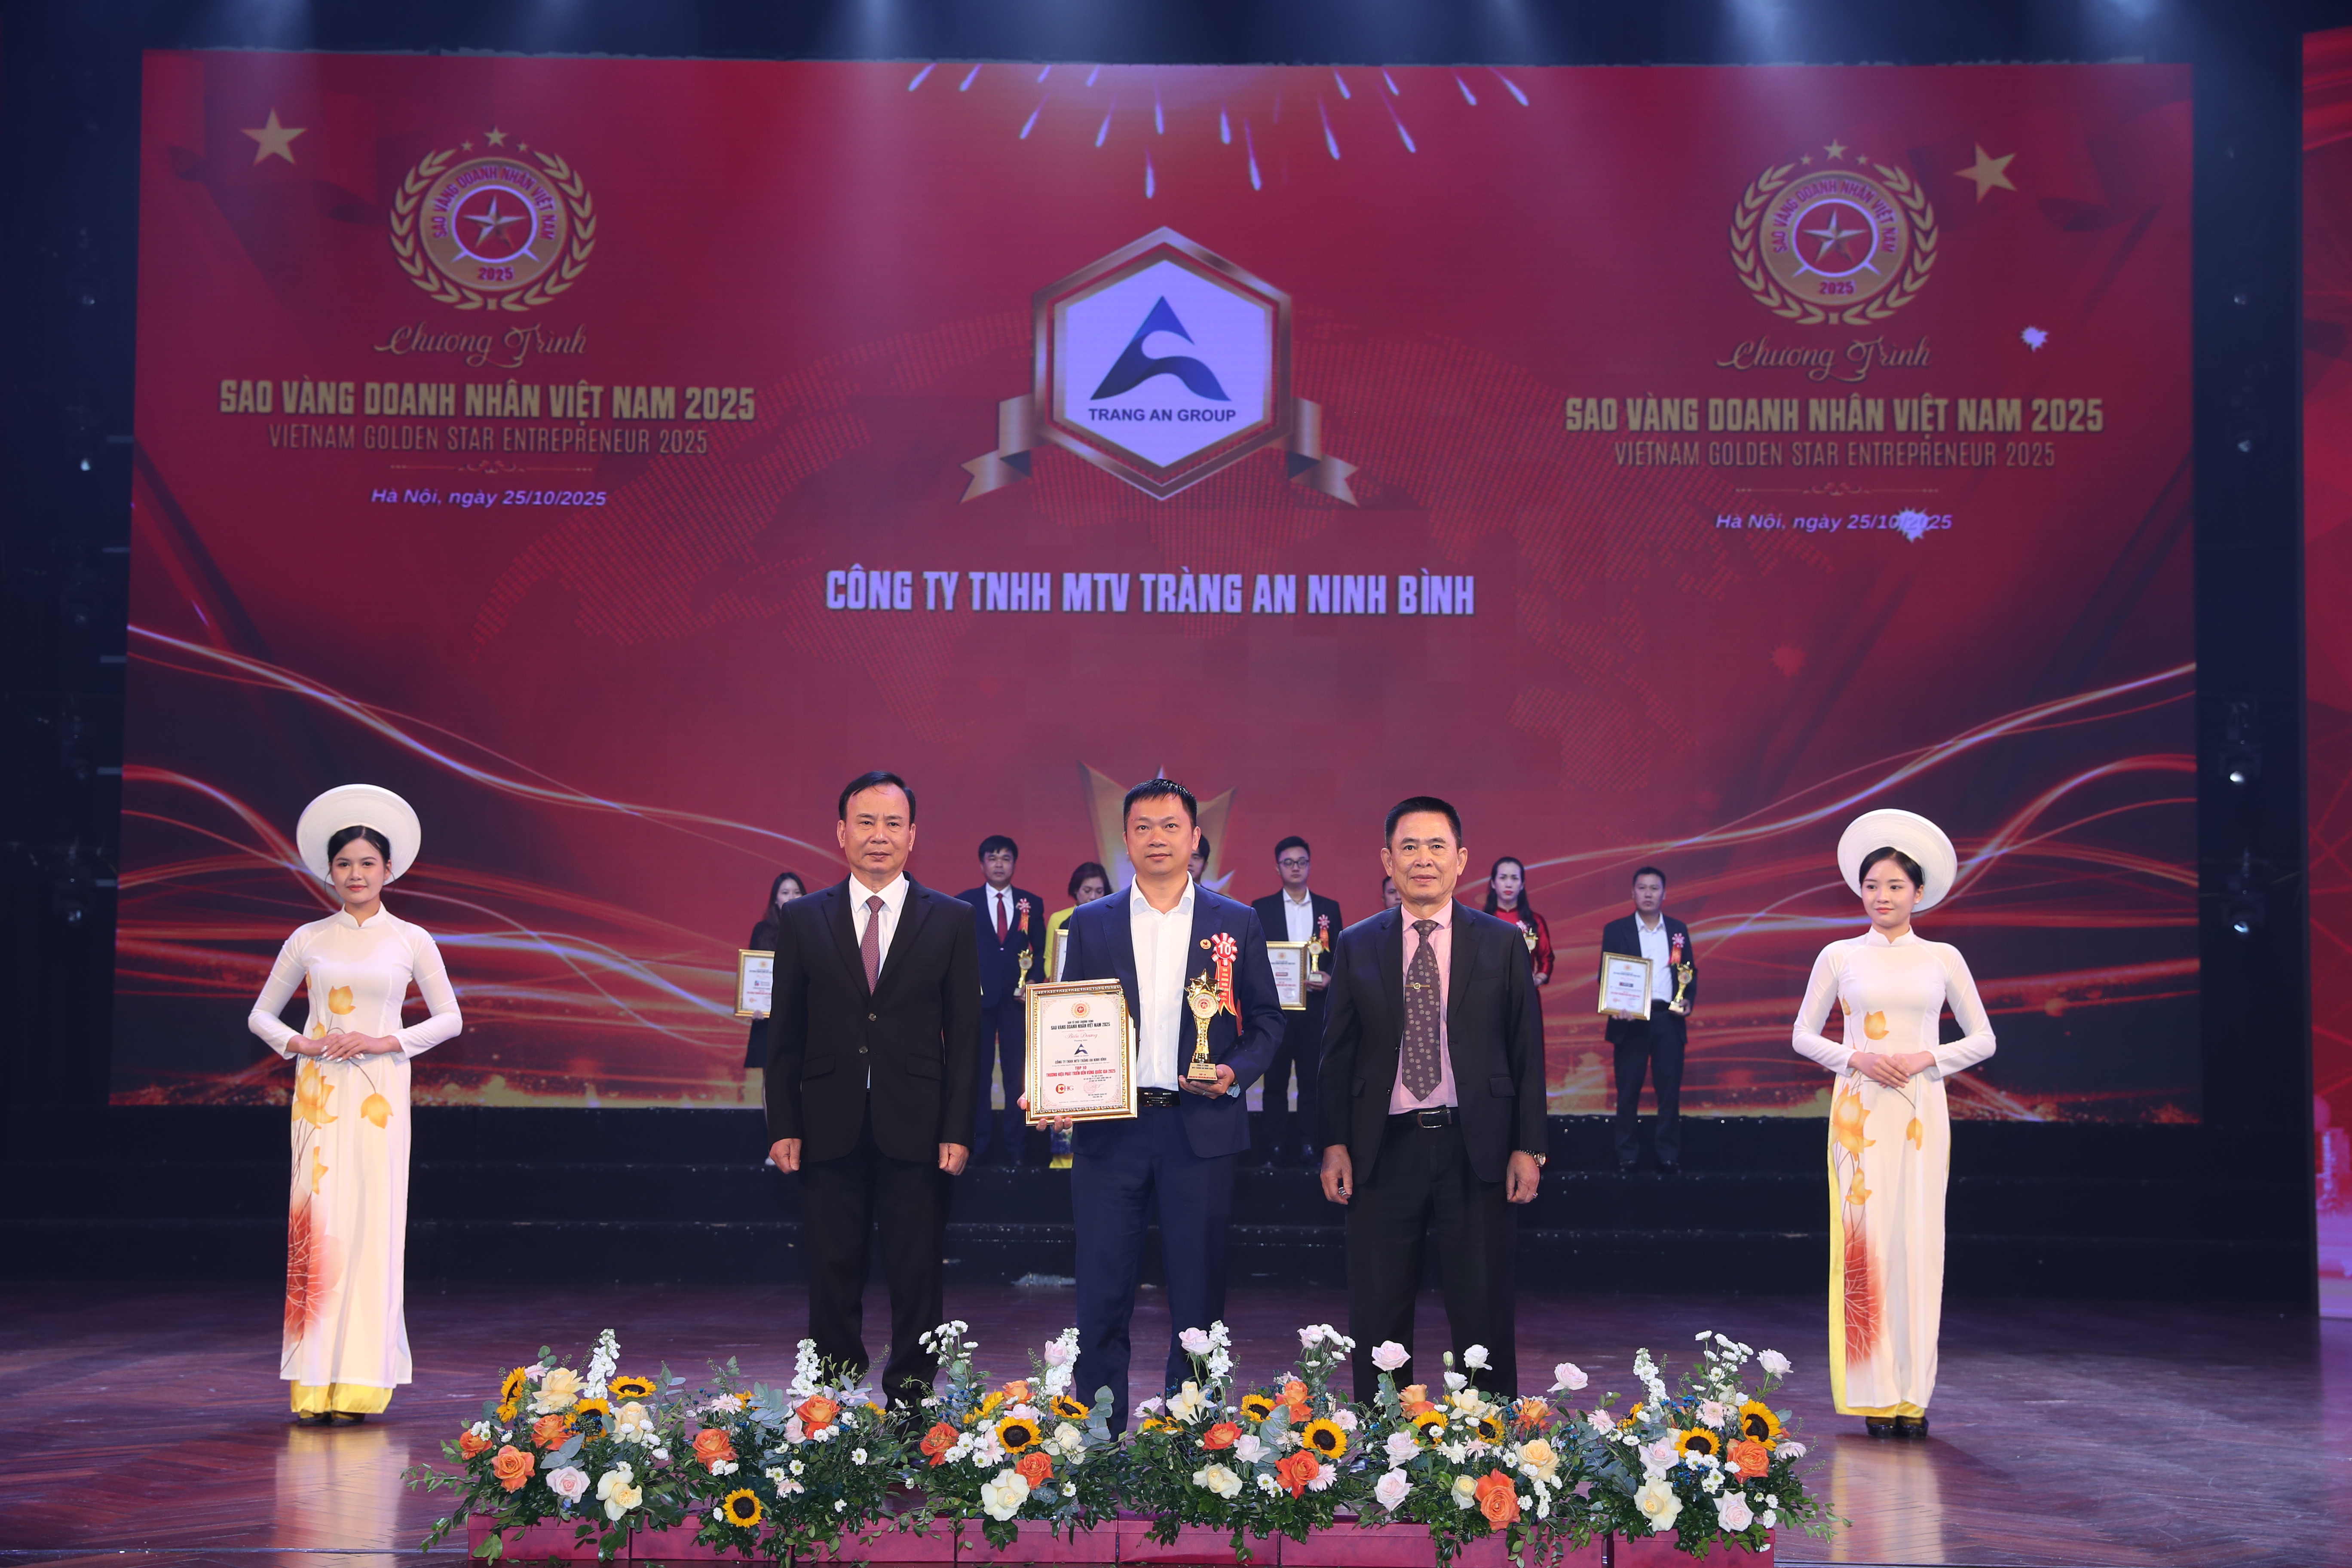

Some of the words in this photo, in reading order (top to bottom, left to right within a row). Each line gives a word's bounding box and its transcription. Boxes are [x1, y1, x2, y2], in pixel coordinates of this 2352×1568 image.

[477, 266, 514, 282] 2025
[1819, 281, 1855, 295] 2025
[374, 321, 494, 368] Chương
[504, 323, 587, 368] Trình
[1716, 335, 1836, 381] Chương
[1847, 336, 1932, 381] Trình
[220, 380, 273, 413] SAO
[282, 375, 355, 414] VÀNG
[364, 383, 455, 416] DOANH
[465, 379, 540, 418] NHÂN
[549, 380, 604, 426] VIỆT
[613, 386, 675, 420] NAM
[685, 387, 755, 420] 2025
[1089, 408, 1145, 421] TRANG
[1149, 409, 1172, 421] AN
[1178, 409, 1236, 422] GROUP
[1566, 398, 1617, 430] SAO
[1626, 392, 1698, 431] VÀNG
[1709, 398, 1799, 431] DOANH
[1809, 392, 1884, 431] NHÂN
[1893, 392, 1948, 440] VIỆT
[1958, 398, 2022, 431] NAM
[2031, 398, 2104, 432] 2025
[269, 424, 355, 448] VIETNAM
[364, 426, 438, 450] GOLDEN
[447, 426, 493, 450] STAR
[503, 427, 649, 453] ENTREPRENEUR
[660, 429, 707, 453] 2025
[1614, 442, 1699, 466] VIETNAM
[1709, 442, 1782, 466] GOLDEN
[1792, 442, 1839, 466] STAR
[1849, 442, 1997, 466] ENTREPRENEUR
[2006, 442, 2055, 467] 2025
[371, 489, 398, 503] Hà
[403, 488, 442, 506] Nội,
[448, 491, 497, 508] ngày
[502, 490, 607, 506] 25/10/2025
[1716, 514, 1742, 529] Hà
[1748, 514, 1786, 532] Nội,
[1793, 516, 1842, 533] ngày
[826, 563, 913, 610] CÔNG
[923, 571, 959, 610] TY
[968, 572, 1051, 611] TNHH
[1062, 573, 1130, 612] MTV
[1139, 566, 1242, 613] TRÀNG
[1252, 574, 1296, 614] AN
[1308, 575, 1387, 614] NINH
[1398, 568, 1474, 615] BÌNH
[1218, 943, 1231, 955] 10
